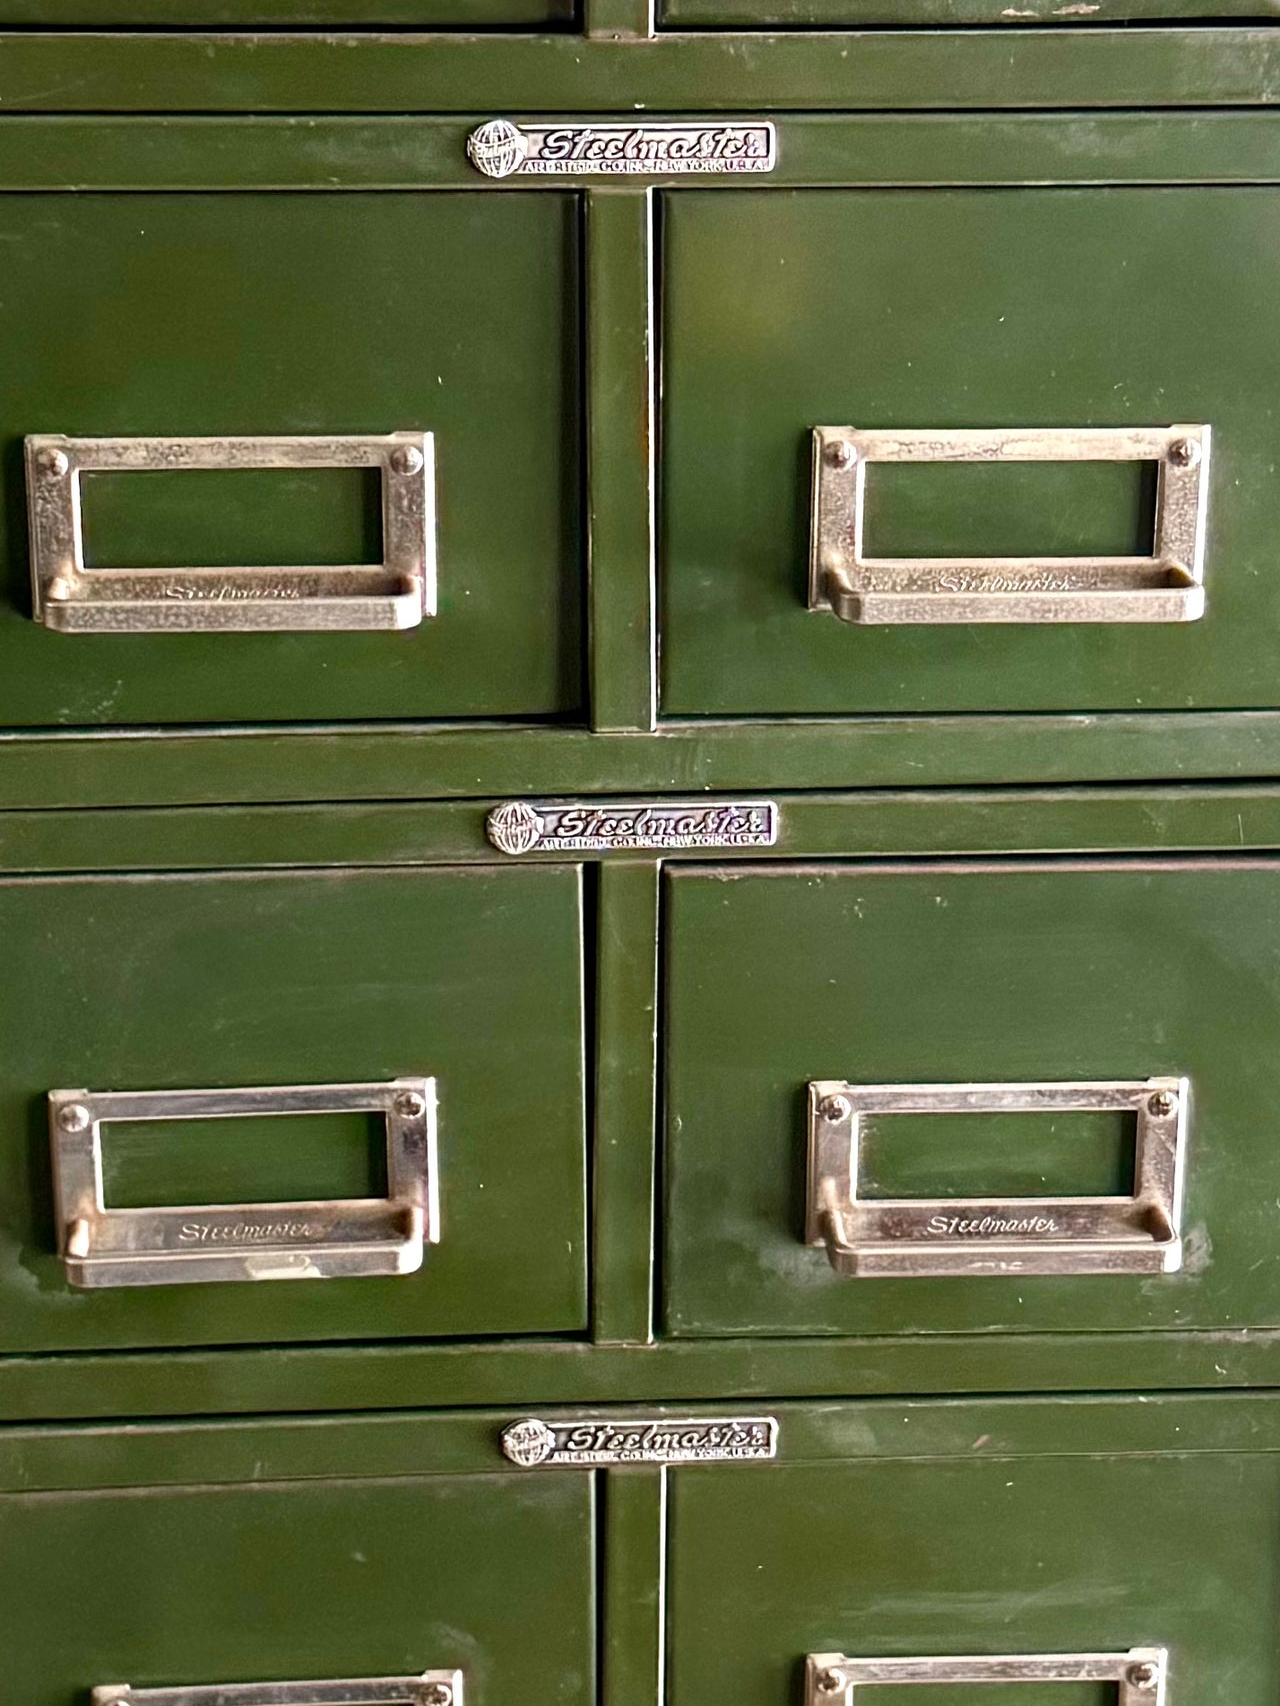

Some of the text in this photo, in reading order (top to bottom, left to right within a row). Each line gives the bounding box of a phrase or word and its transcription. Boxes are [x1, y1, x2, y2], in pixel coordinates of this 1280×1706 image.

[540, 127, 768, 159] Steelmaster
[556, 808, 765, 837] Steelmaster
[178, 1221, 314, 1242] Steelmaster
[927, 1216, 1060, 1235] Steelmaster
[567, 1422, 764, 1451] Steelmaster
